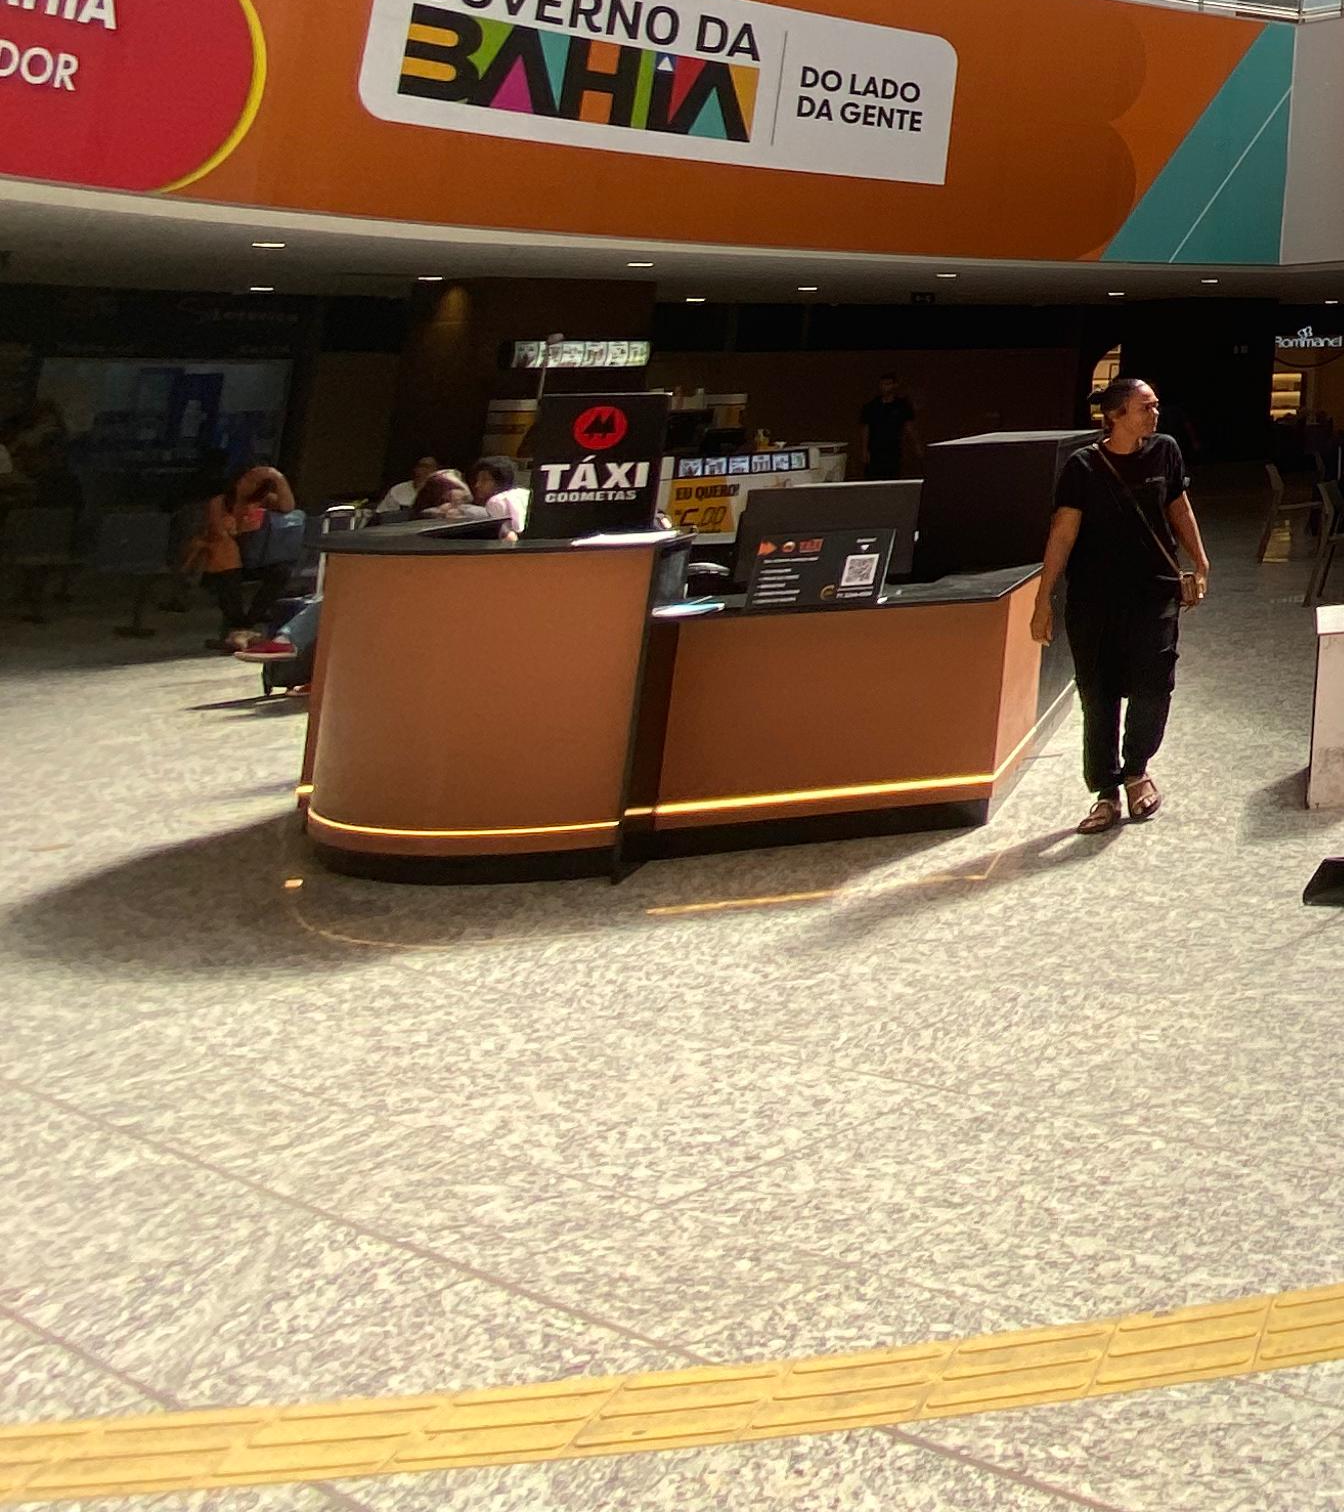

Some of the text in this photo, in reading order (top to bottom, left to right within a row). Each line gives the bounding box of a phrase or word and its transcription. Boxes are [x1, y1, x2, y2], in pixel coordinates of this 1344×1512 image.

[695, 14, 761, 61] DA
[397, 2, 762, 143] BAHIA
[801, 66, 921, 104] DO LADO
[797, 95, 923, 133] DA GENTE
[540, 453, 650, 491] TÁXI
